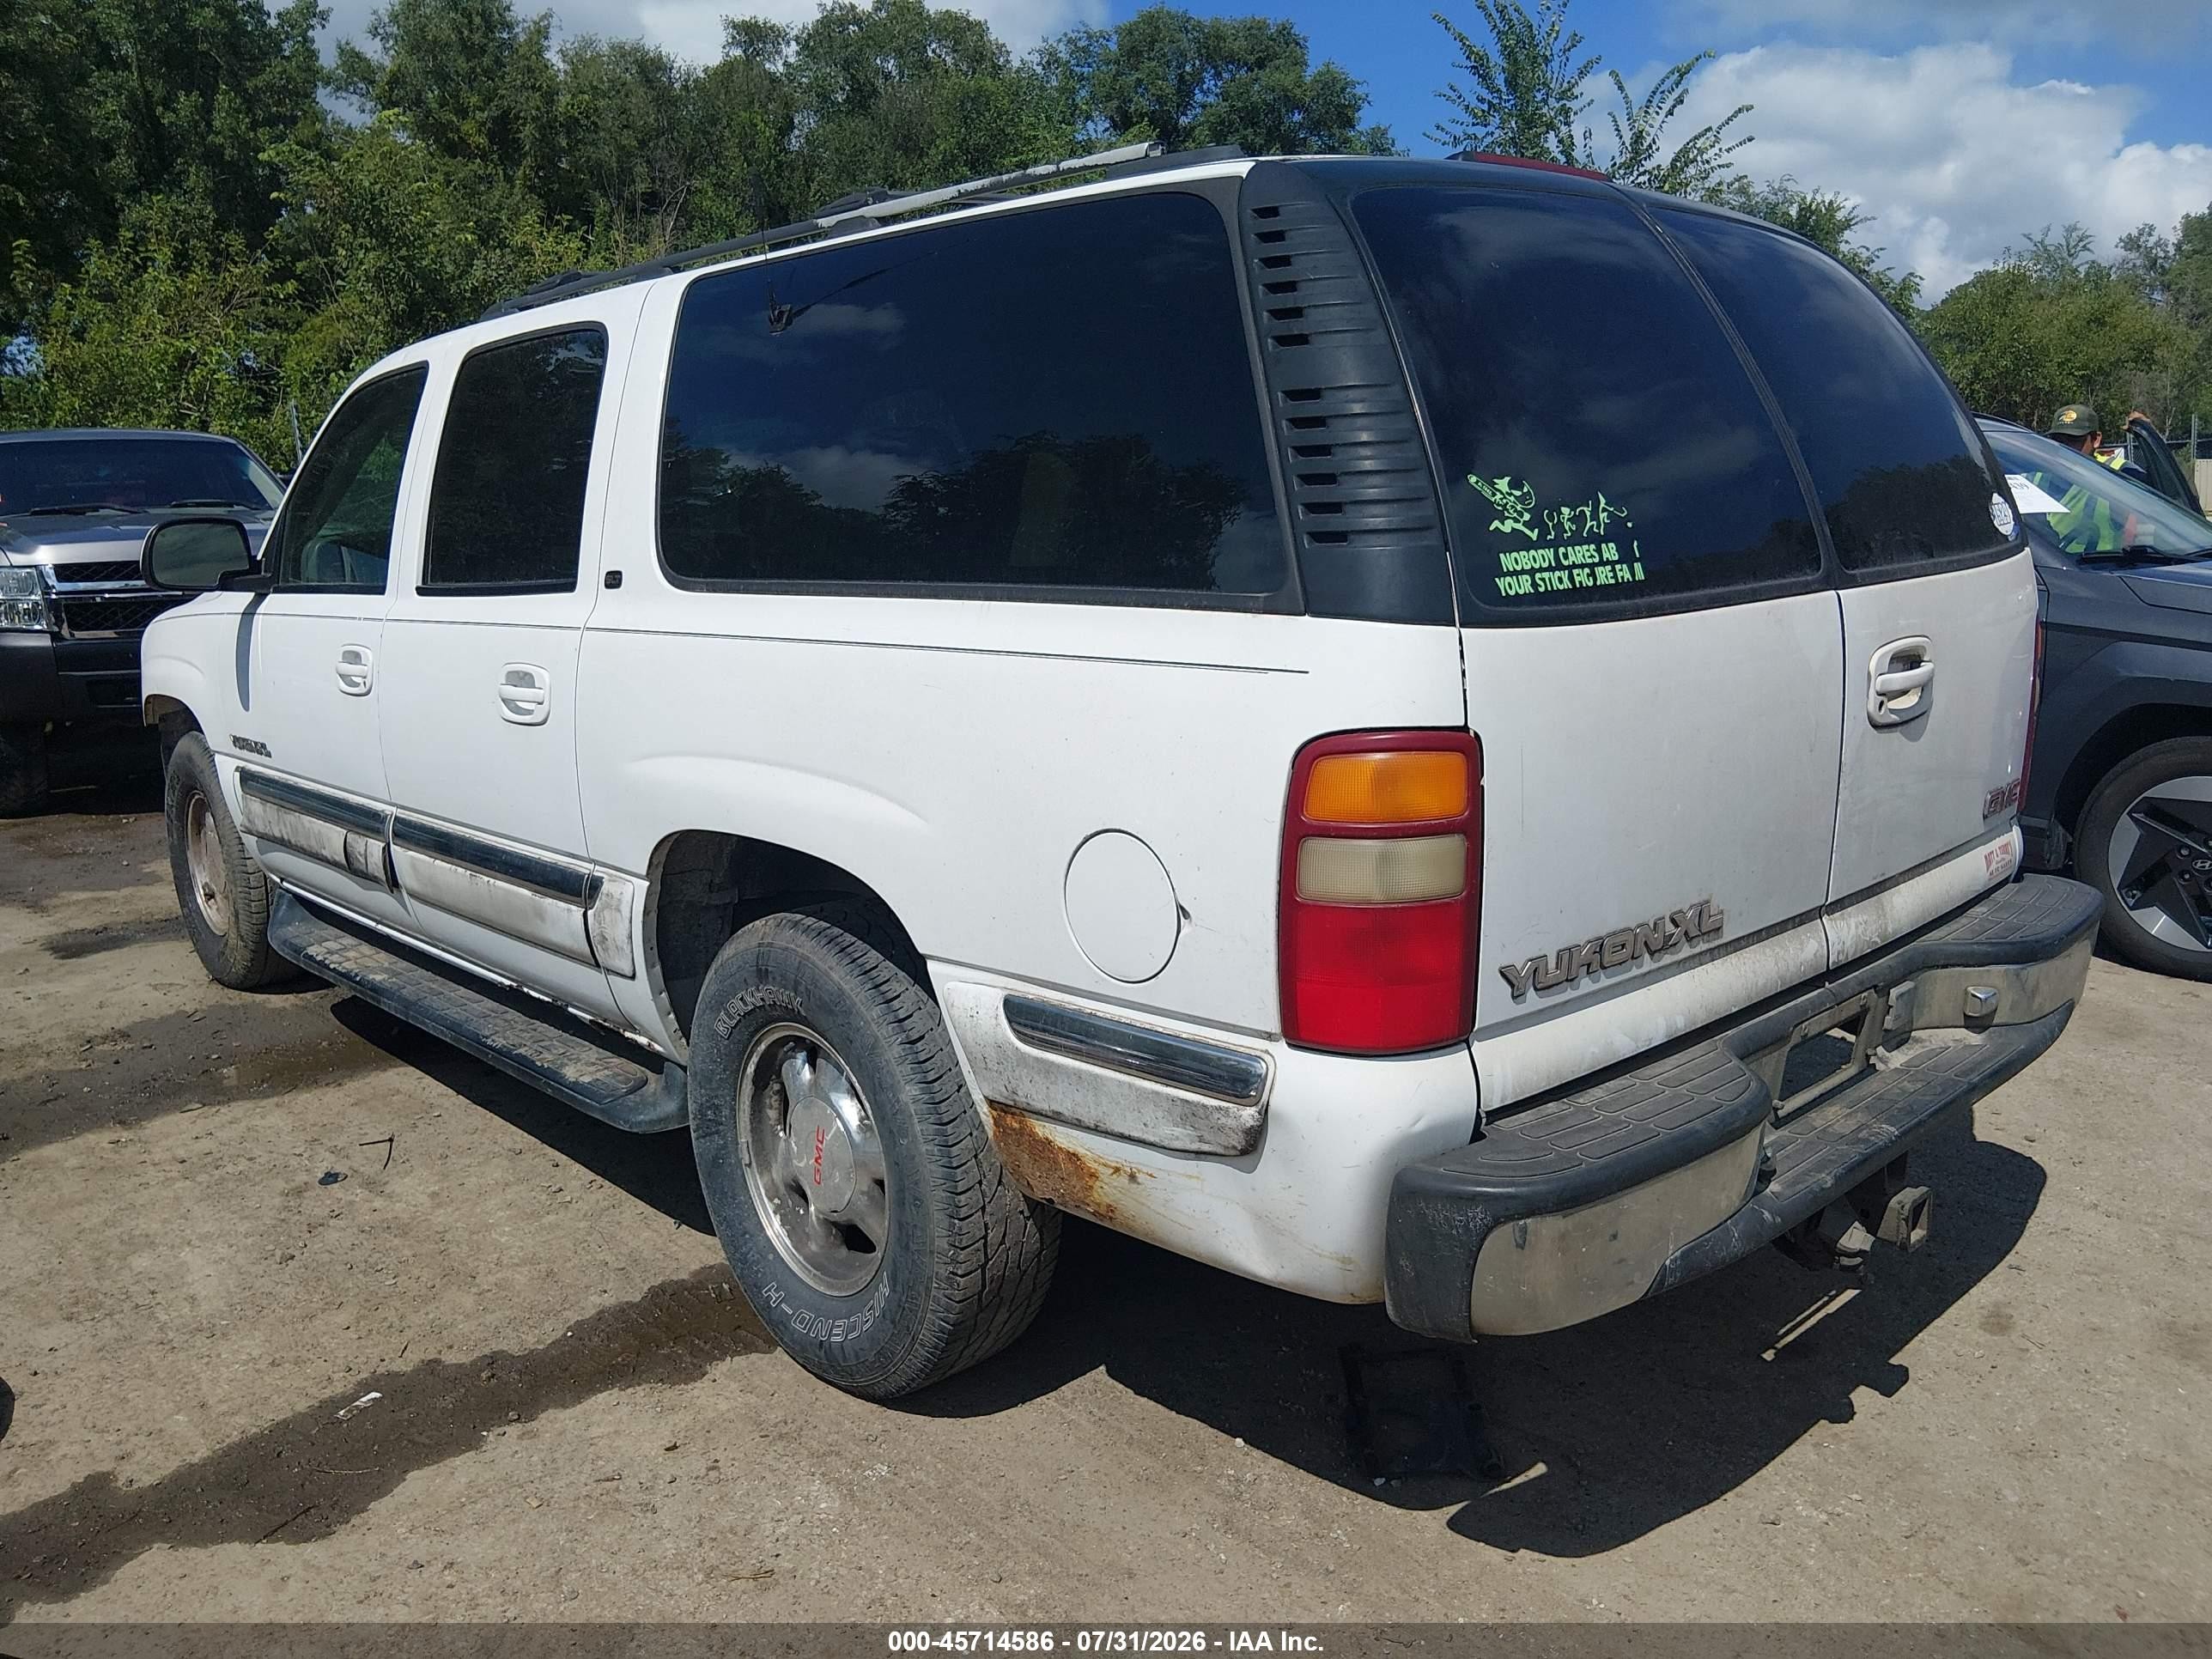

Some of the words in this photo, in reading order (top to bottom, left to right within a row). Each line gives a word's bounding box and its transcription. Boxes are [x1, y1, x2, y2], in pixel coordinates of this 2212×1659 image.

[1494, 574, 1534, 596] YOUR
[1534, 569, 1572, 592] STICK
[1498, 548, 1555, 572] NOBODY
[1558, 544, 1599, 566] CARES
[1498, 916, 1665, 997] YUKON
[1669, 901, 1723, 943] XL
[714, 986, 806, 1039] BLACKHAWK
[814, 1125, 825, 1185] GMC
[762, 1270, 890, 1342] HISCEND-H
